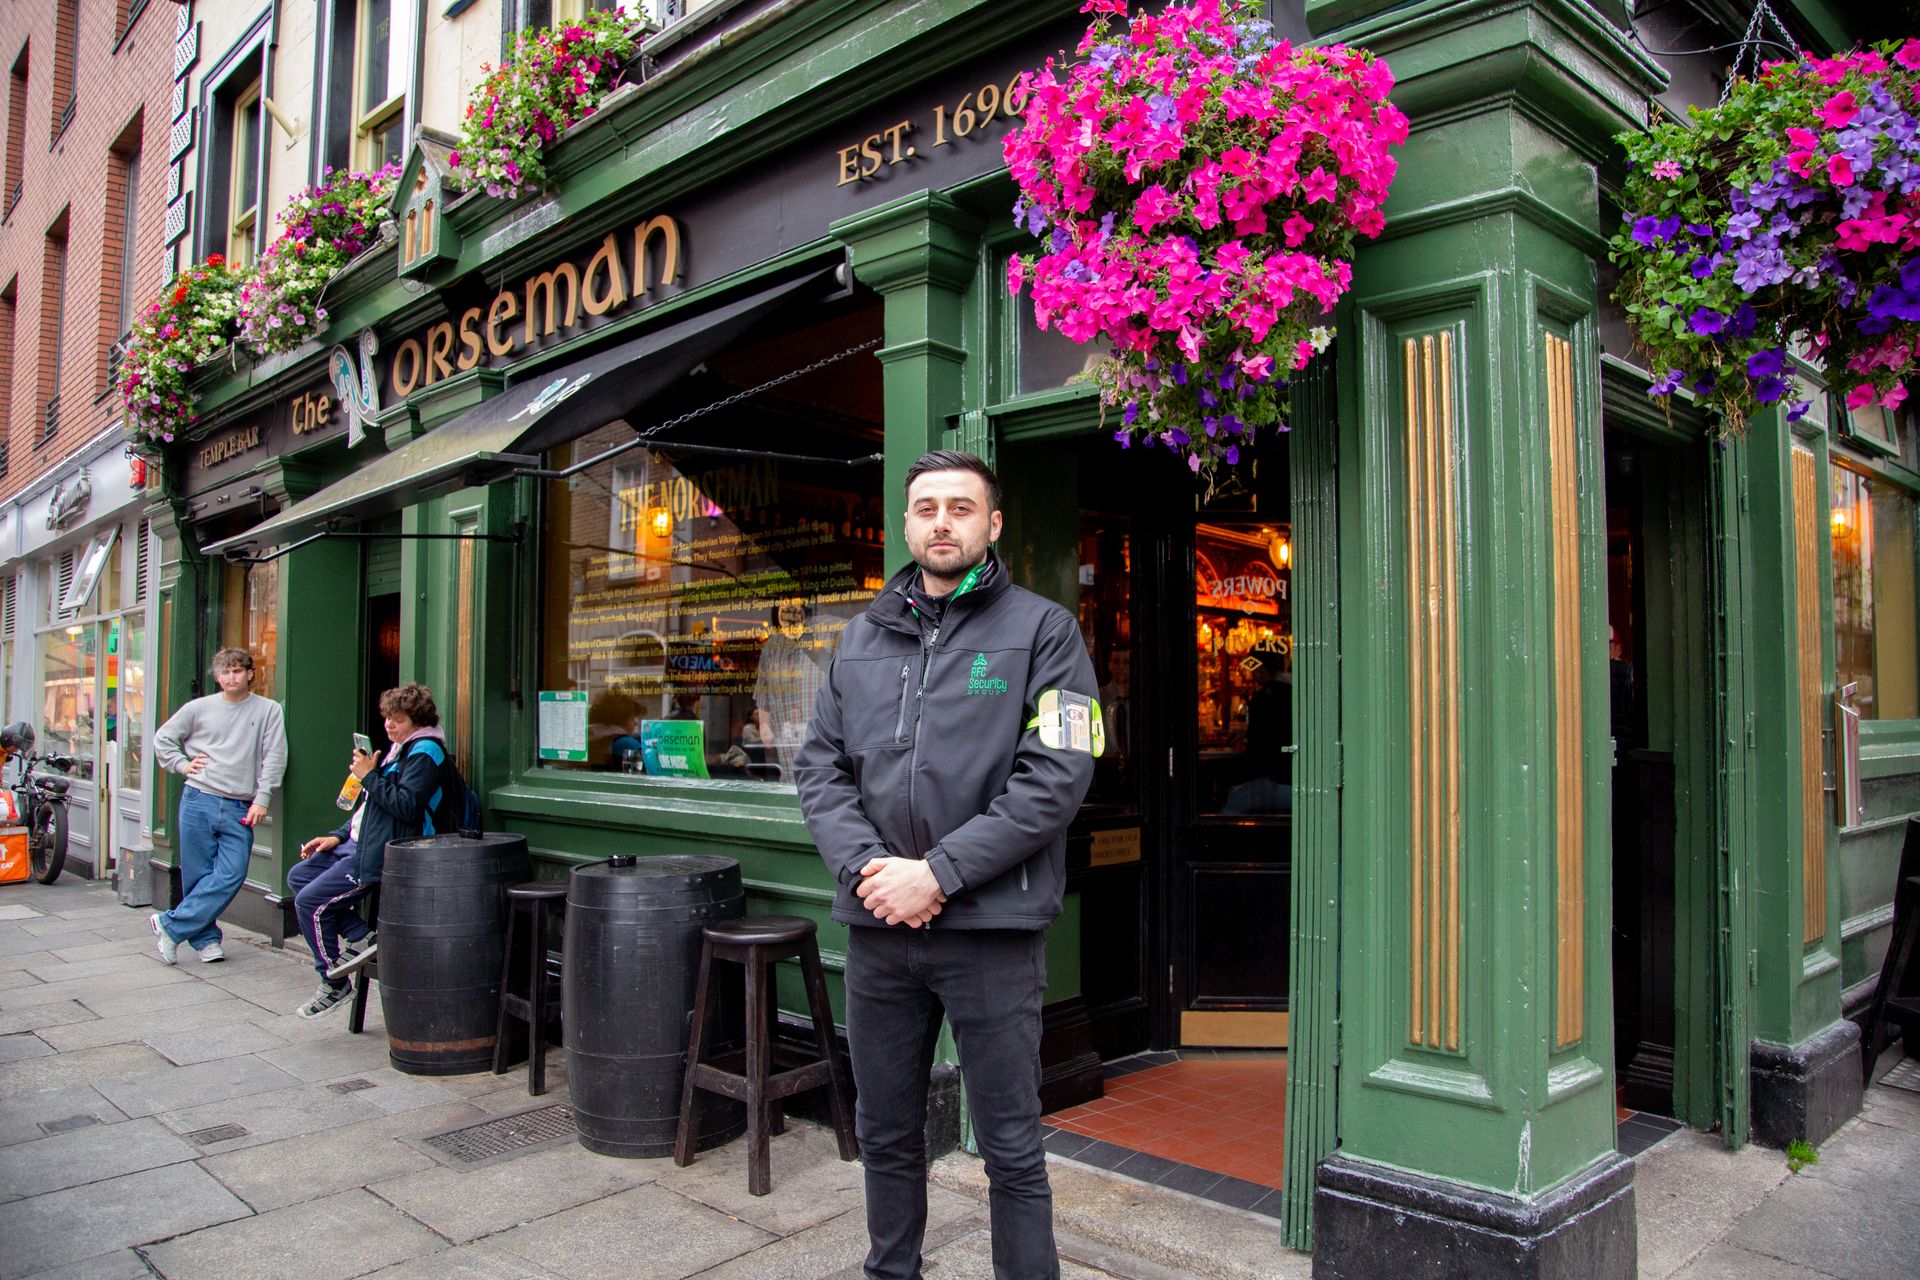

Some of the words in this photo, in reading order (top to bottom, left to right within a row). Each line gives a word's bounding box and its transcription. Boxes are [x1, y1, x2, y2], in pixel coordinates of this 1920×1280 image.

[836, 120, 916, 187] EST.
[932, 71, 1028, 148] 1696
[291, 391, 331, 436] The
[200, 433, 237, 470] TEMPLE
[236, 425, 259, 453] BAR
[619, 484, 655, 532] THE
[660, 458, 780, 523] NORSEMAN
[709, 546, 735, 560] founded
[748, 543, 770, 556] capital
[786, 536, 810, 550] Dublin
[718, 534, 742, 546] Vikings
[698, 602, 731, 615] contingent
[731, 601, 742, 611] led
[743, 599, 753, 612] by
[752, 597, 775, 611] Sigurd
[810, 594, 817, 604] &
[817, 591, 841, 604] Brodir
[842, 590, 850, 601] of
[851, 590, 876, 602] Mann.
[711, 590, 731, 602] forces
[1213, 635, 1288, 656] POWERS
[971, 666, 987, 678] AFC
[968, 677, 1008, 693] Security
